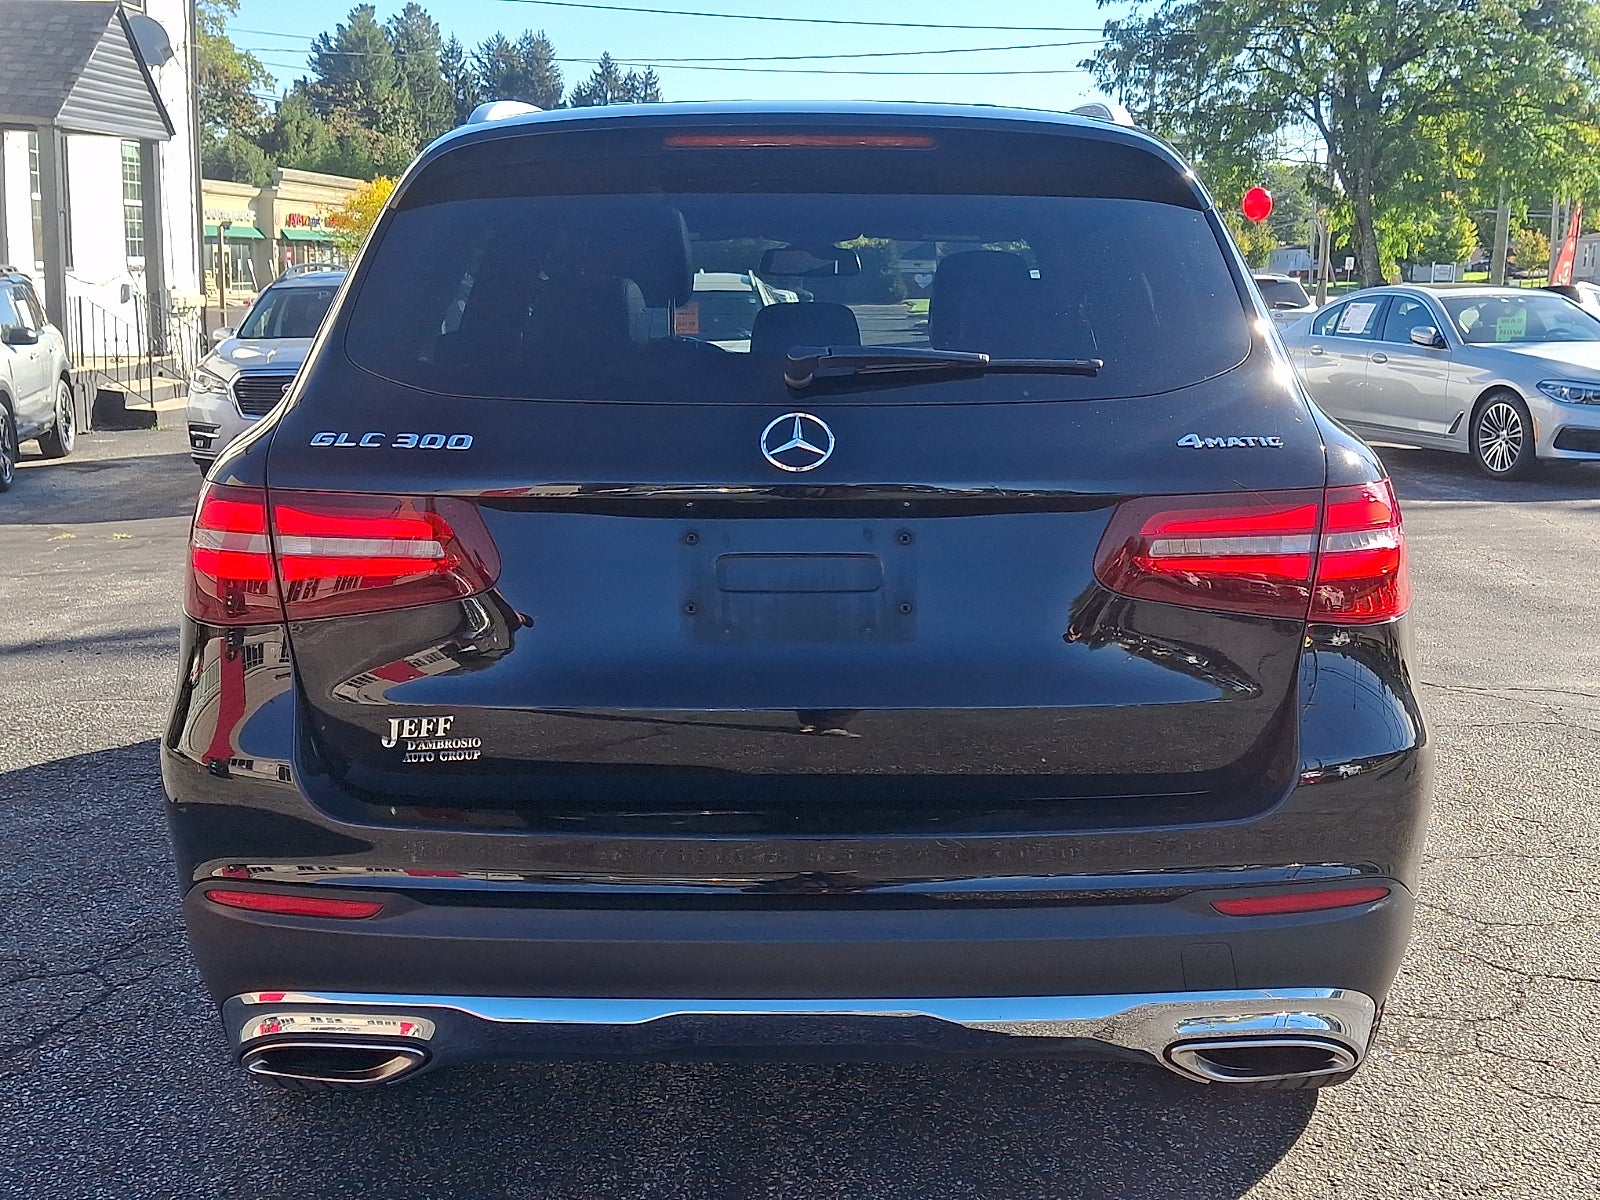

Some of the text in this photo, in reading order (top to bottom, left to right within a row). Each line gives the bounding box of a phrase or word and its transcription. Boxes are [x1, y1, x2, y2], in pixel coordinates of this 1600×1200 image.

[309, 432, 474, 450] GLC 300
[1177, 433, 1284, 449] 4MATIC
[381, 715, 454, 748] JEFF
[407, 737, 482, 751] D'AMBROSIO
[402, 750, 481, 763] AUTO GROUP
